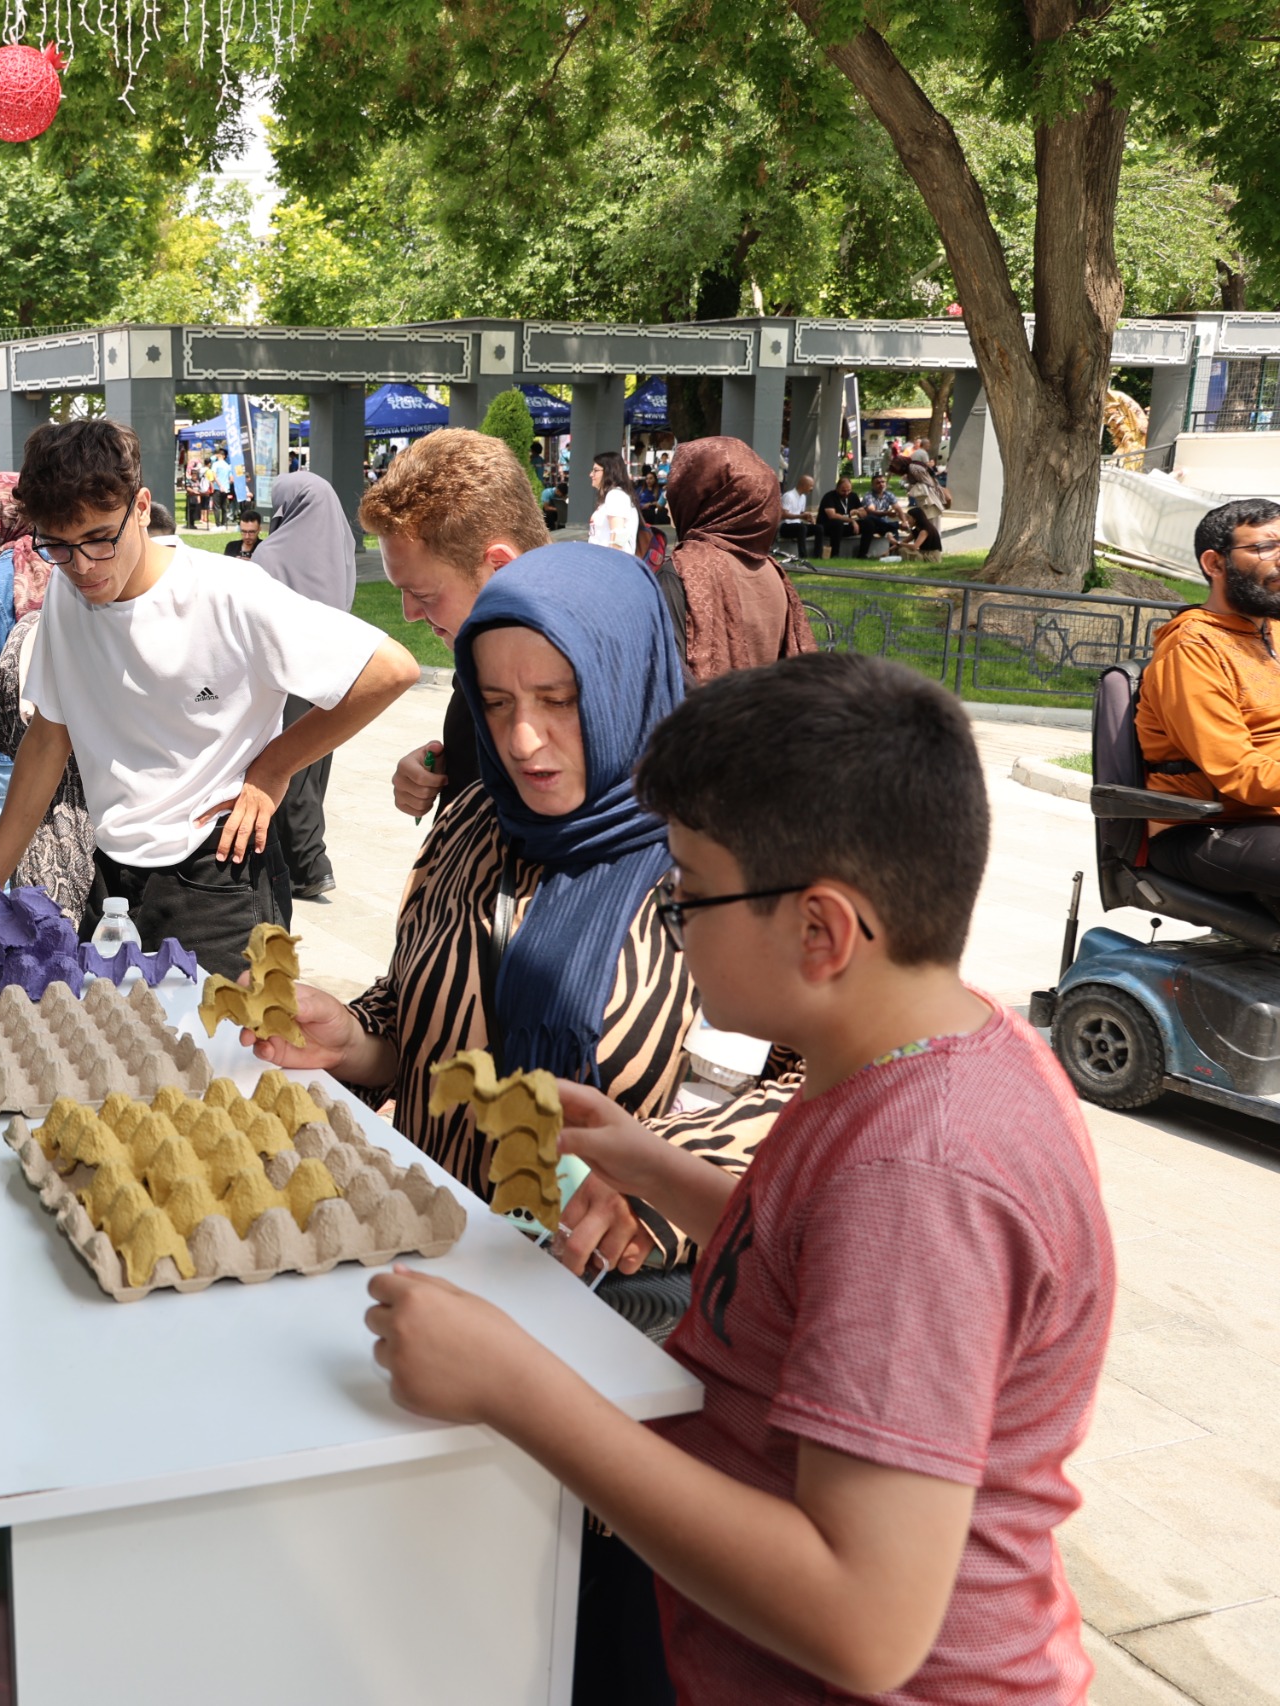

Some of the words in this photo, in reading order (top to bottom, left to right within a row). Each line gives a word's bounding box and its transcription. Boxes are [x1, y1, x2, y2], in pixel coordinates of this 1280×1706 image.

[391, 401, 438, 410] KONYA
[195, 430, 226, 438] sporkon
[376, 427, 400, 435] KONYA
[195, 694, 219, 702] adidas
